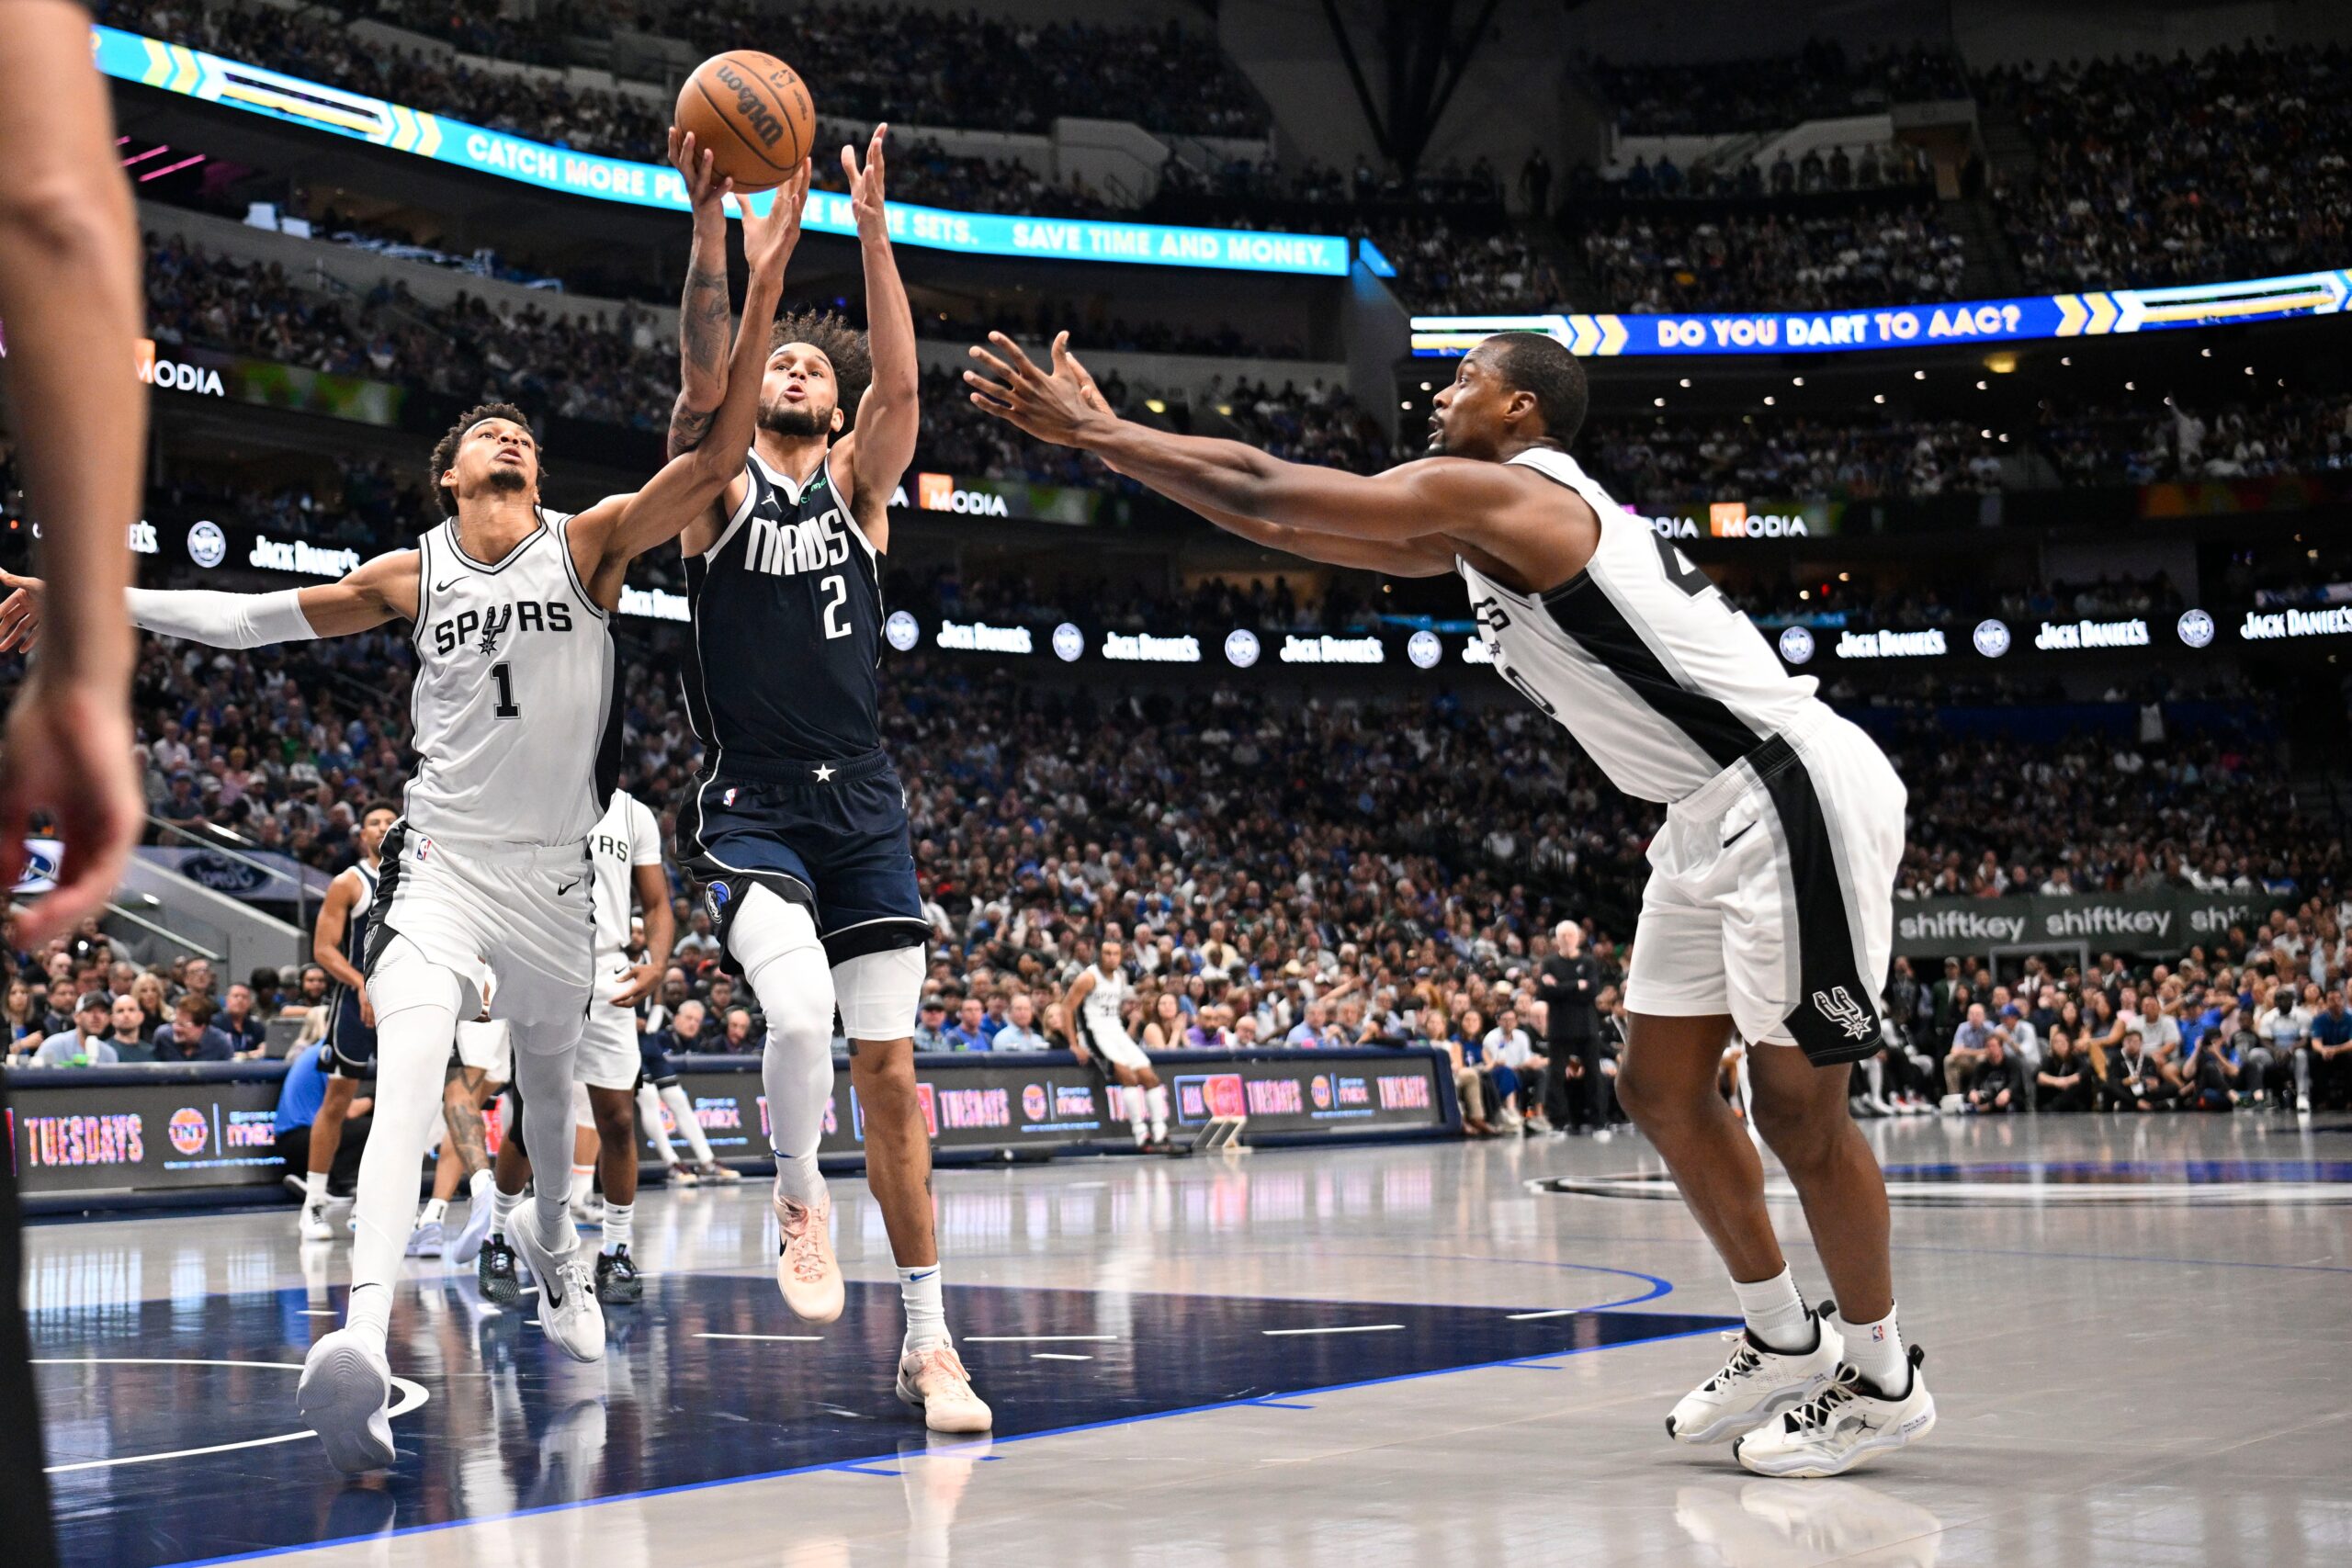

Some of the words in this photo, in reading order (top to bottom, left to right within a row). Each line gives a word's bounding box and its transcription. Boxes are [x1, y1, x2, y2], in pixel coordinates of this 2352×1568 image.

[716, 65, 783, 149] Wilson
[466, 134, 558, 181] CATCH
[564, 159, 648, 196] MORE
[913, 209, 979, 245] SETS.
[1012, 222, 1080, 251] SAVE
[1088, 227, 1150, 256] TIME
[1159, 231, 1220, 261] AND
[1227, 236, 1329, 267] MONEY.
[1657, 319, 1706, 347] DO
[1712, 318, 1778, 347] YOU
[1786, 313, 1869, 346] DART
[1874, 310, 1920, 342] TO
[1928, 303, 2021, 338] AAC?
[929, 489, 1009, 517] MODIA
[1721, 515, 1808, 538] MODIA
[743, 508, 850, 576] MAVS
[435, 601, 572, 657] SPURS
[820, 574, 852, 639] 2
[489, 660, 522, 721] 1
[1899, 909, 2025, 943] shiftkey
[2046, 905, 2172, 937] shiftkey
[24, 1113, 144, 1167] TUESDAYS
